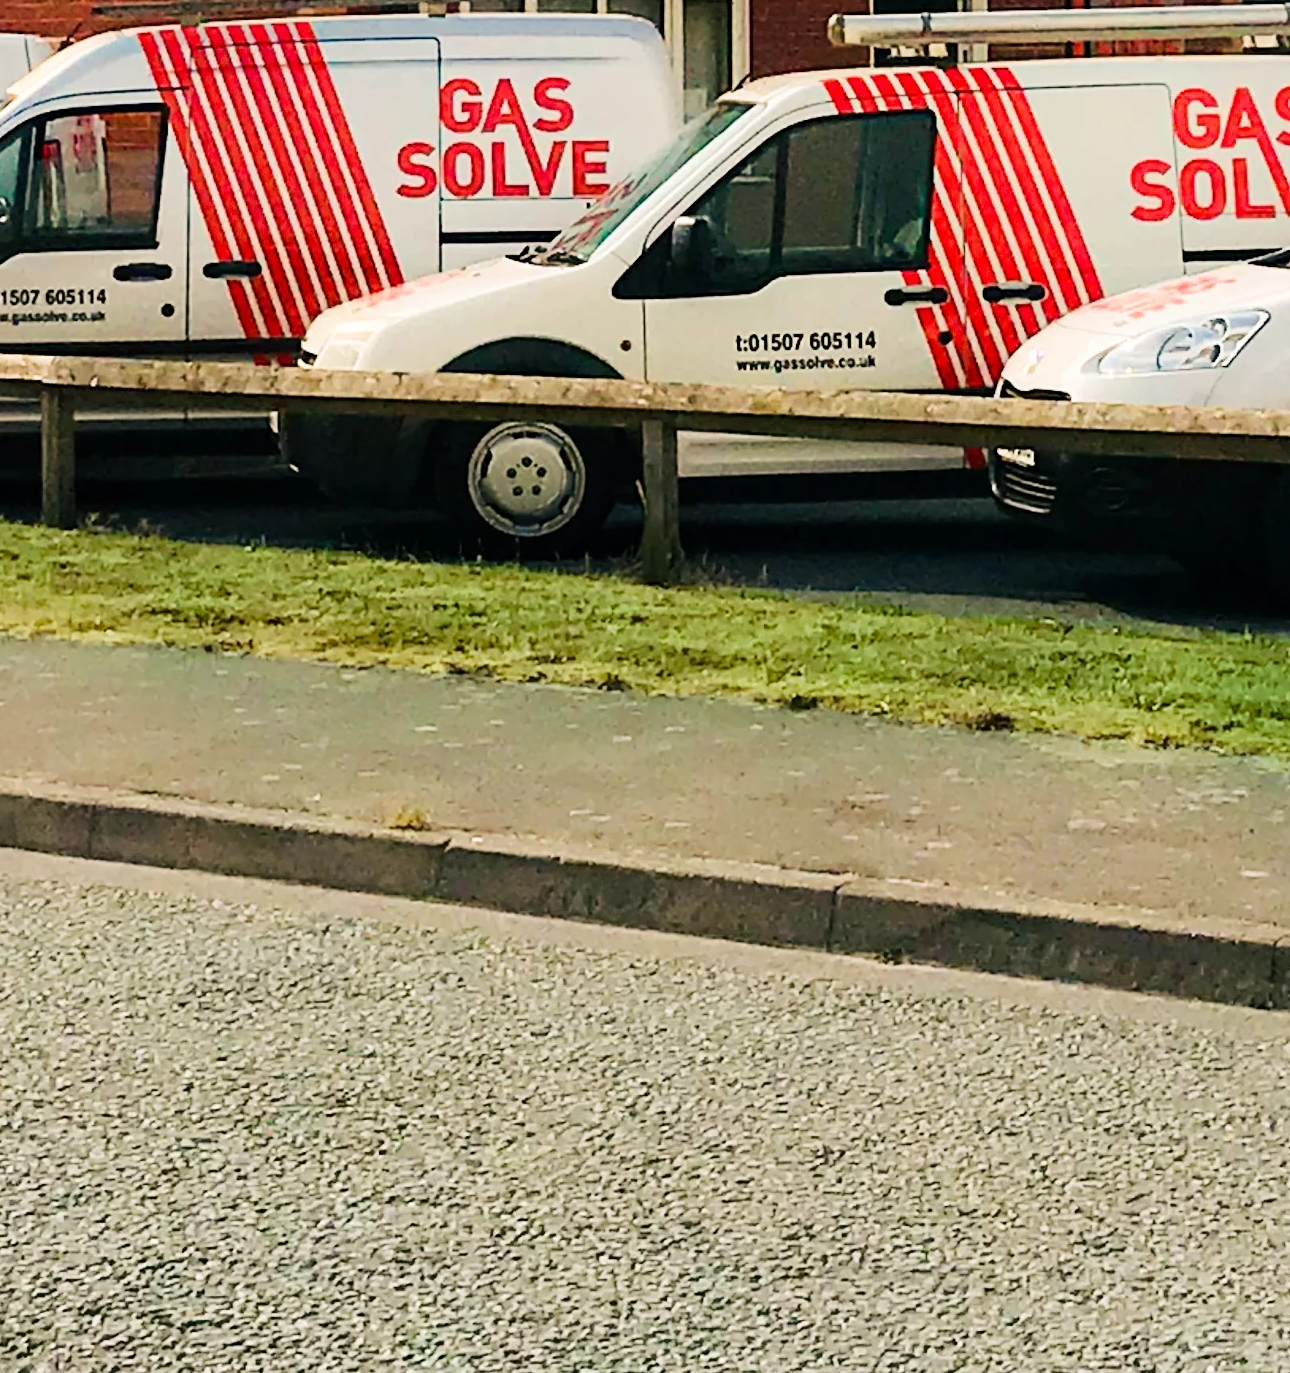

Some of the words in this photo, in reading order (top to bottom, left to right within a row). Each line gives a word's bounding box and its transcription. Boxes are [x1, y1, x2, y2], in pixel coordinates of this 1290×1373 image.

[440, 77, 574, 134] GAS
[396, 140, 610, 197] SOLVE
[45, 288, 106, 304] 605114
[736, 333, 804, 351] t:01507
[809, 330, 876, 350] 605114
[736, 355, 876, 373] www.gassolve.co.uk
